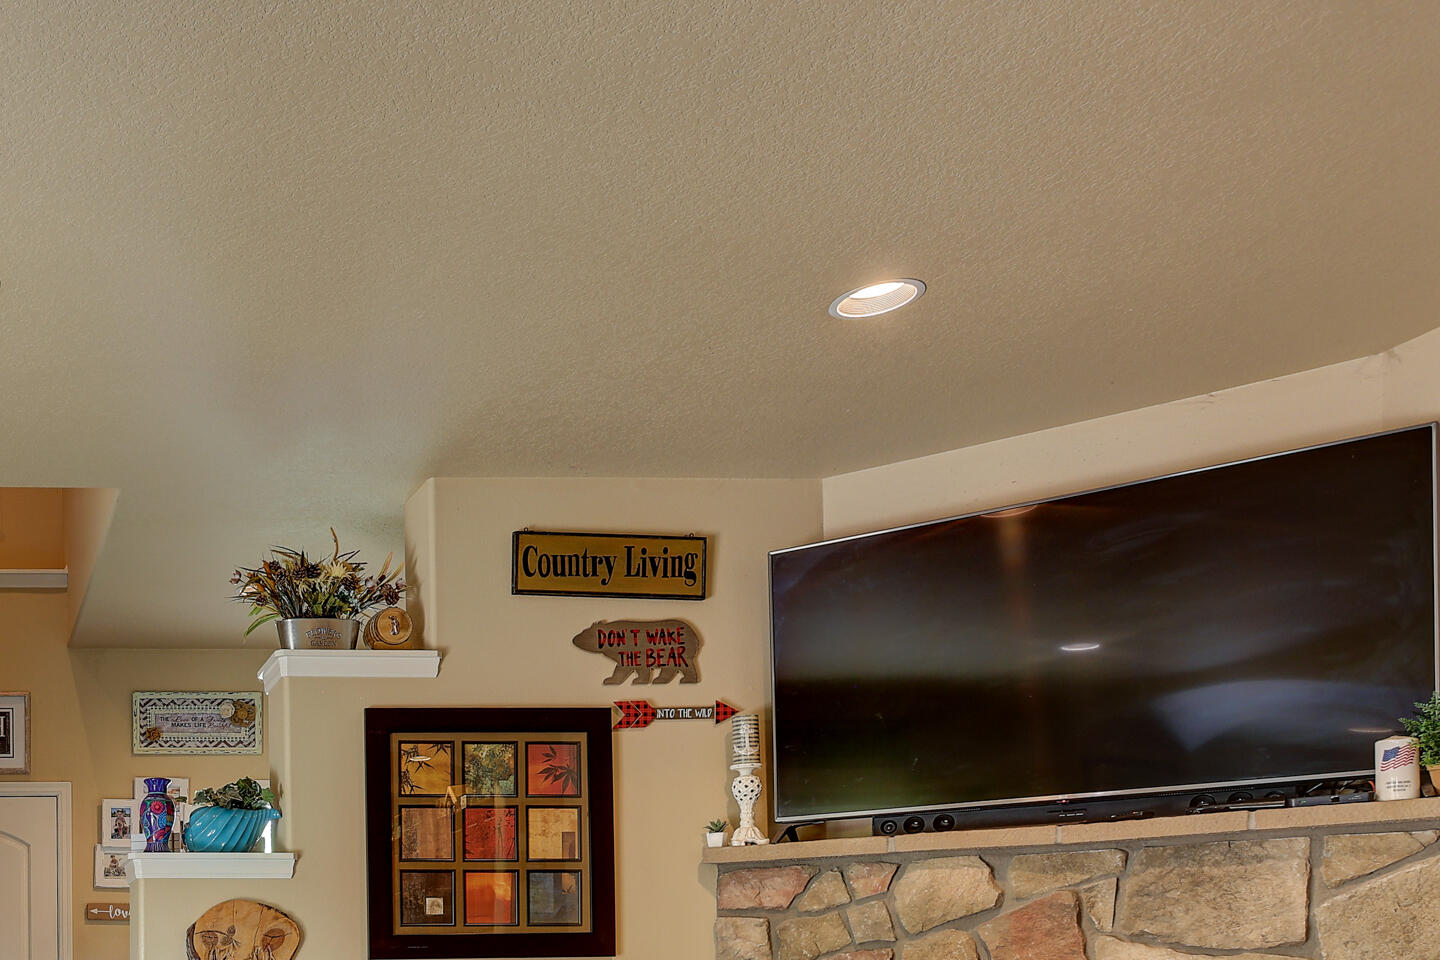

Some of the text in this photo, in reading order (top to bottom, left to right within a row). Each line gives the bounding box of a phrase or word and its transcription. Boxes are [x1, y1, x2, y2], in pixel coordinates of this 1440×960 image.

[521, 545, 699, 587] Country Living
[597, 626, 685, 649] DON'T WAKE
[618, 646, 689, 668] THE BEAR
[656, 708, 713, 719] INTO THE WILD
[110, 904, 130, 919] lov
